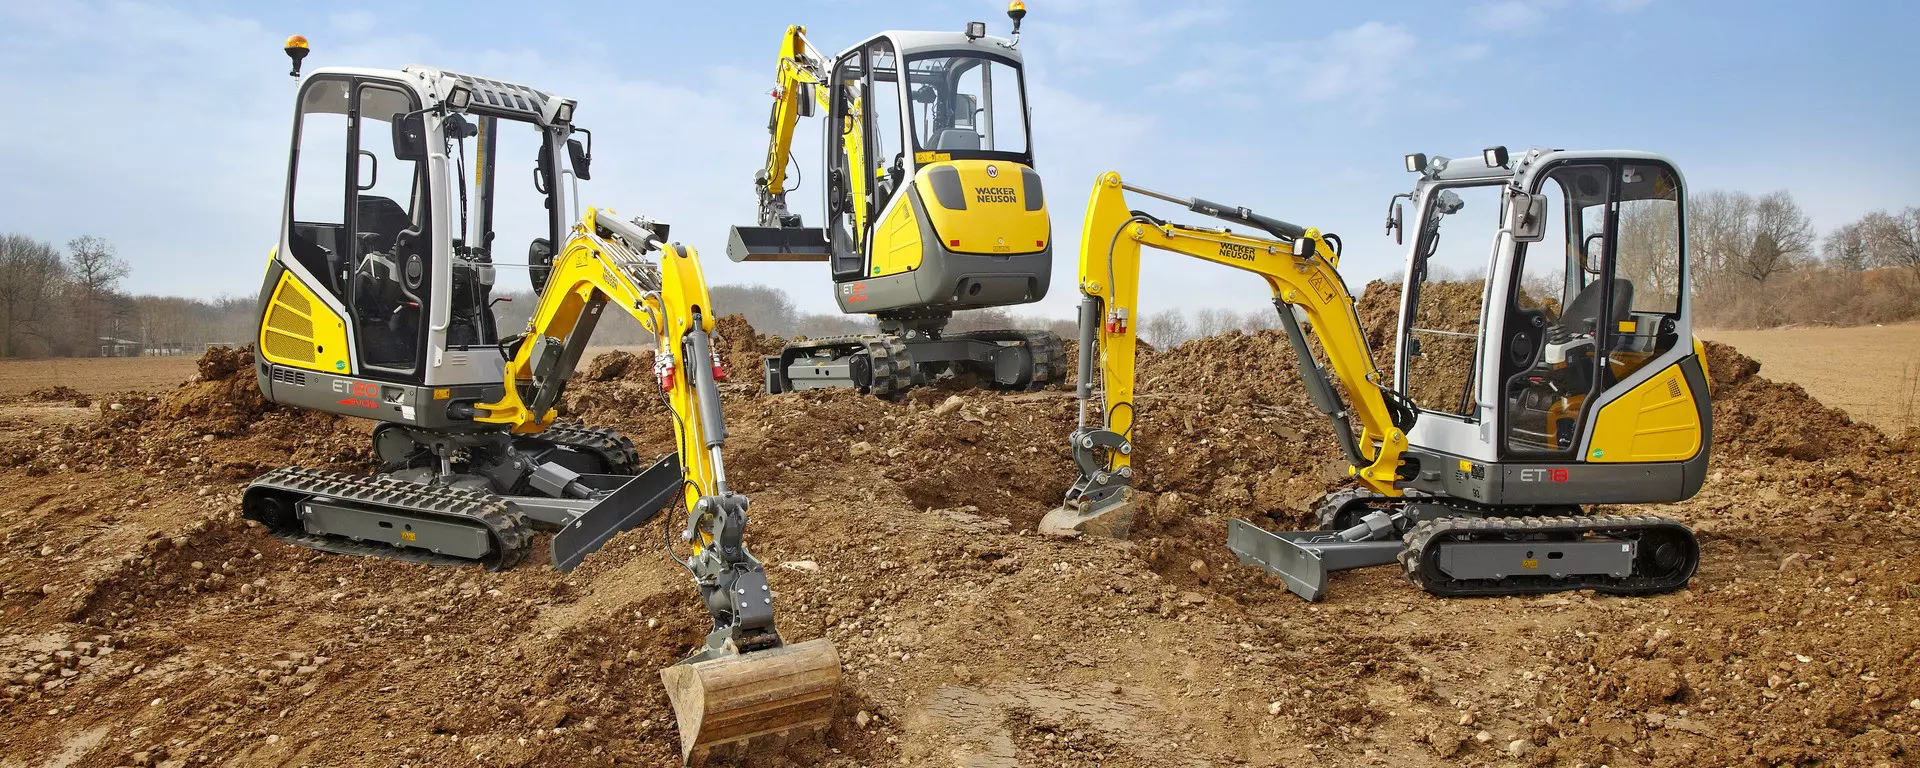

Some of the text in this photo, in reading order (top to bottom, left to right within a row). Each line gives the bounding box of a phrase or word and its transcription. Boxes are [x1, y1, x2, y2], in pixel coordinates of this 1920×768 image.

[975, 187, 1015, 196] WACKER
[977, 195, 1017, 203] NEUSON
[1220, 242, 1255, 255] WACKER
[1219, 249, 1255, 261] NEUSON
[332, 379, 379, 397] ET20
[1520, 468, 1569, 483] ET18
